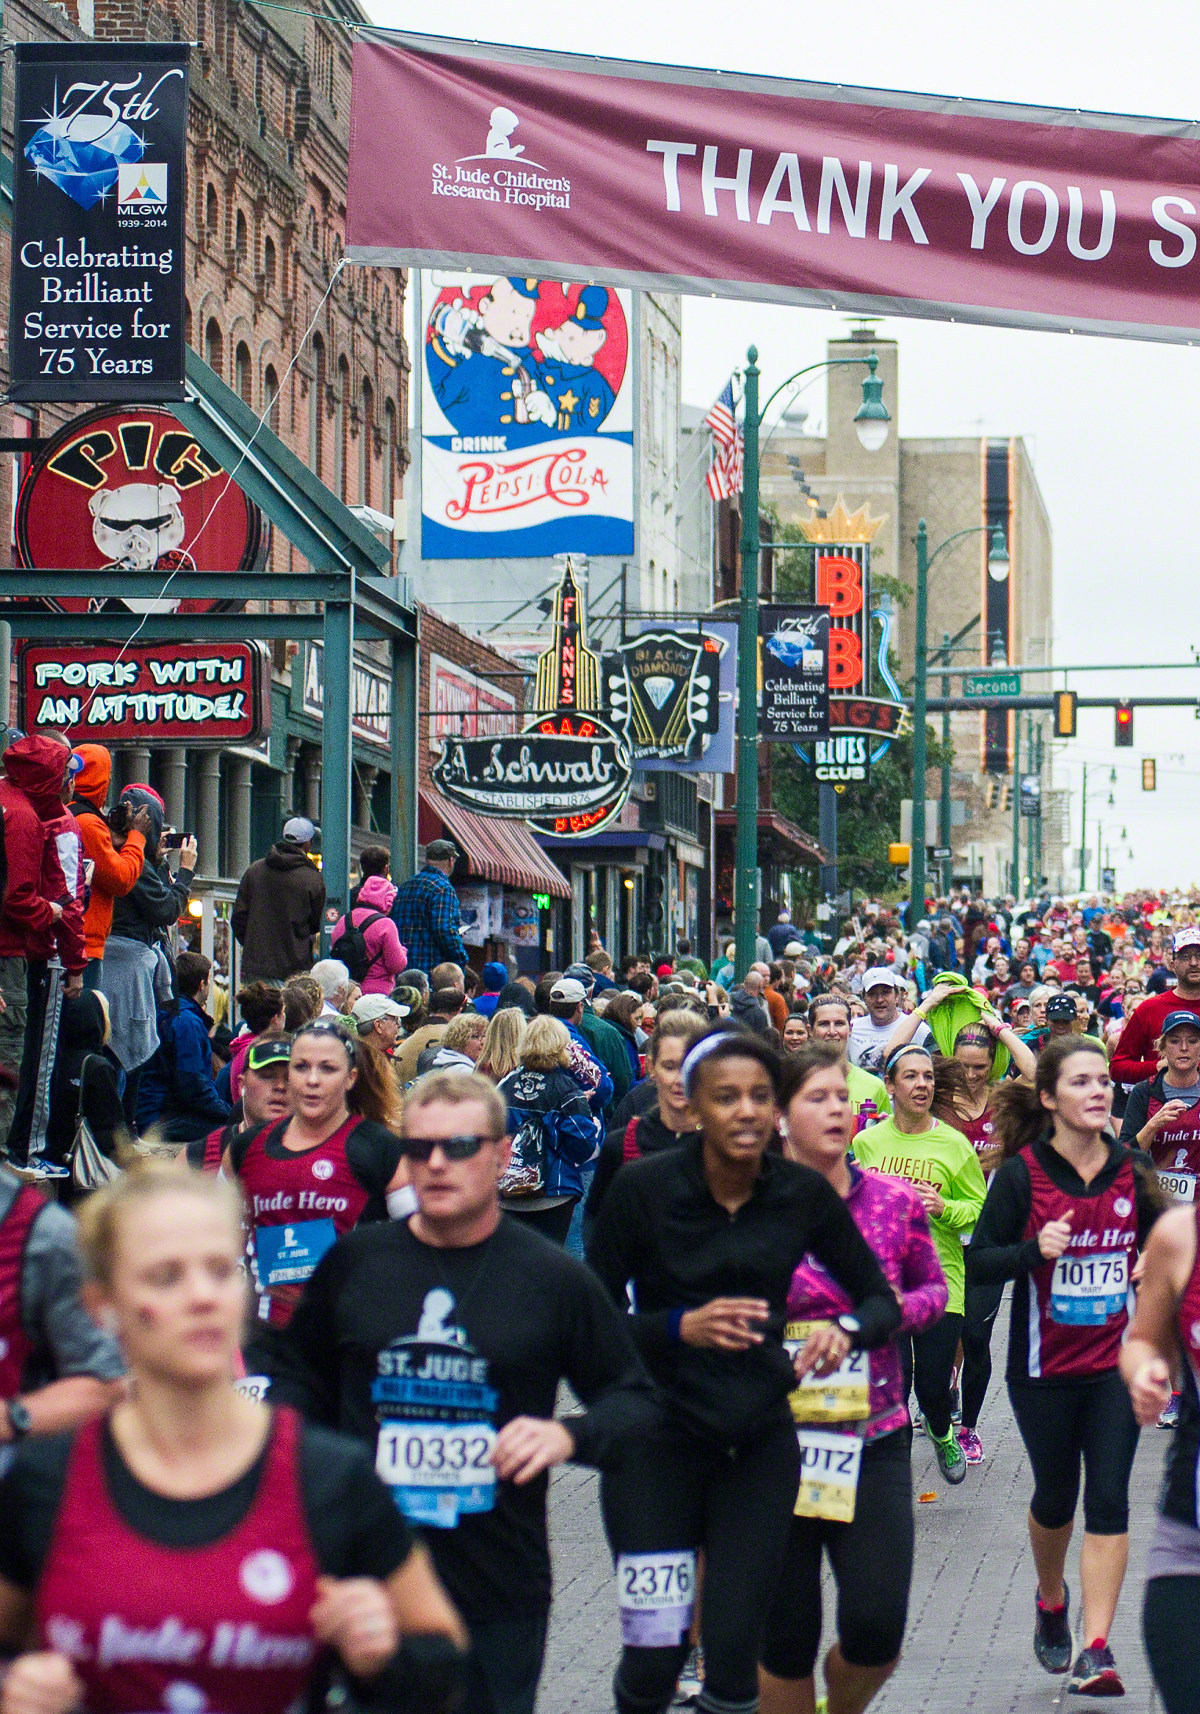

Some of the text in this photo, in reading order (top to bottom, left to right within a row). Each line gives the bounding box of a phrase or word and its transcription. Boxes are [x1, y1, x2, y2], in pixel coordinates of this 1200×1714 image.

[62, 69, 184, 142] 75th
[432, 163, 571, 192] St. Jude Children's
[432, 178, 571, 211] Research Hospital
[645, 139, 933, 246] THANK
[956, 172, 1116, 261] YOU
[117, 205, 168, 215] MLGW
[117, 219, 168, 228] 1939-2014
[20, 237, 173, 275] Celebrating
[40, 272, 153, 304] Brilliant
[24, 307, 171, 340] Service for
[39, 347, 153, 375] 75 Years
[47, 421, 224, 491] PIG
[451, 436, 508, 452] DRINK
[35, 656, 243, 688] PORK WITH
[764, 677, 825, 694] Celebrating
[773, 692, 818, 706] Brilliant
[967, 680, 1017, 693] Second
[36, 690, 248, 725] AN ATTITUDE!
[766, 705, 825, 720] Service for
[540, 717, 596, 738] BAR
[773, 720, 818, 733] 75 Years
[482, 743, 618, 783] Schwab
[815, 736, 866, 764] BLUES
[815, 766, 867, 780] CLUB
[474, 792, 591, 808] ESTABLISHED 1876
[1162, 1131, 1190, 1145] Jude
[253, 1190, 350, 1218] Jude Hero
[1070, 1228, 1098, 1248] ude
[1058, 1260, 1124, 1286] 10175
[377, 1350, 488, 1384] ST. JUDE
[388, 1436, 492, 1471] 10332
[622, 1562, 690, 1596] 2376
